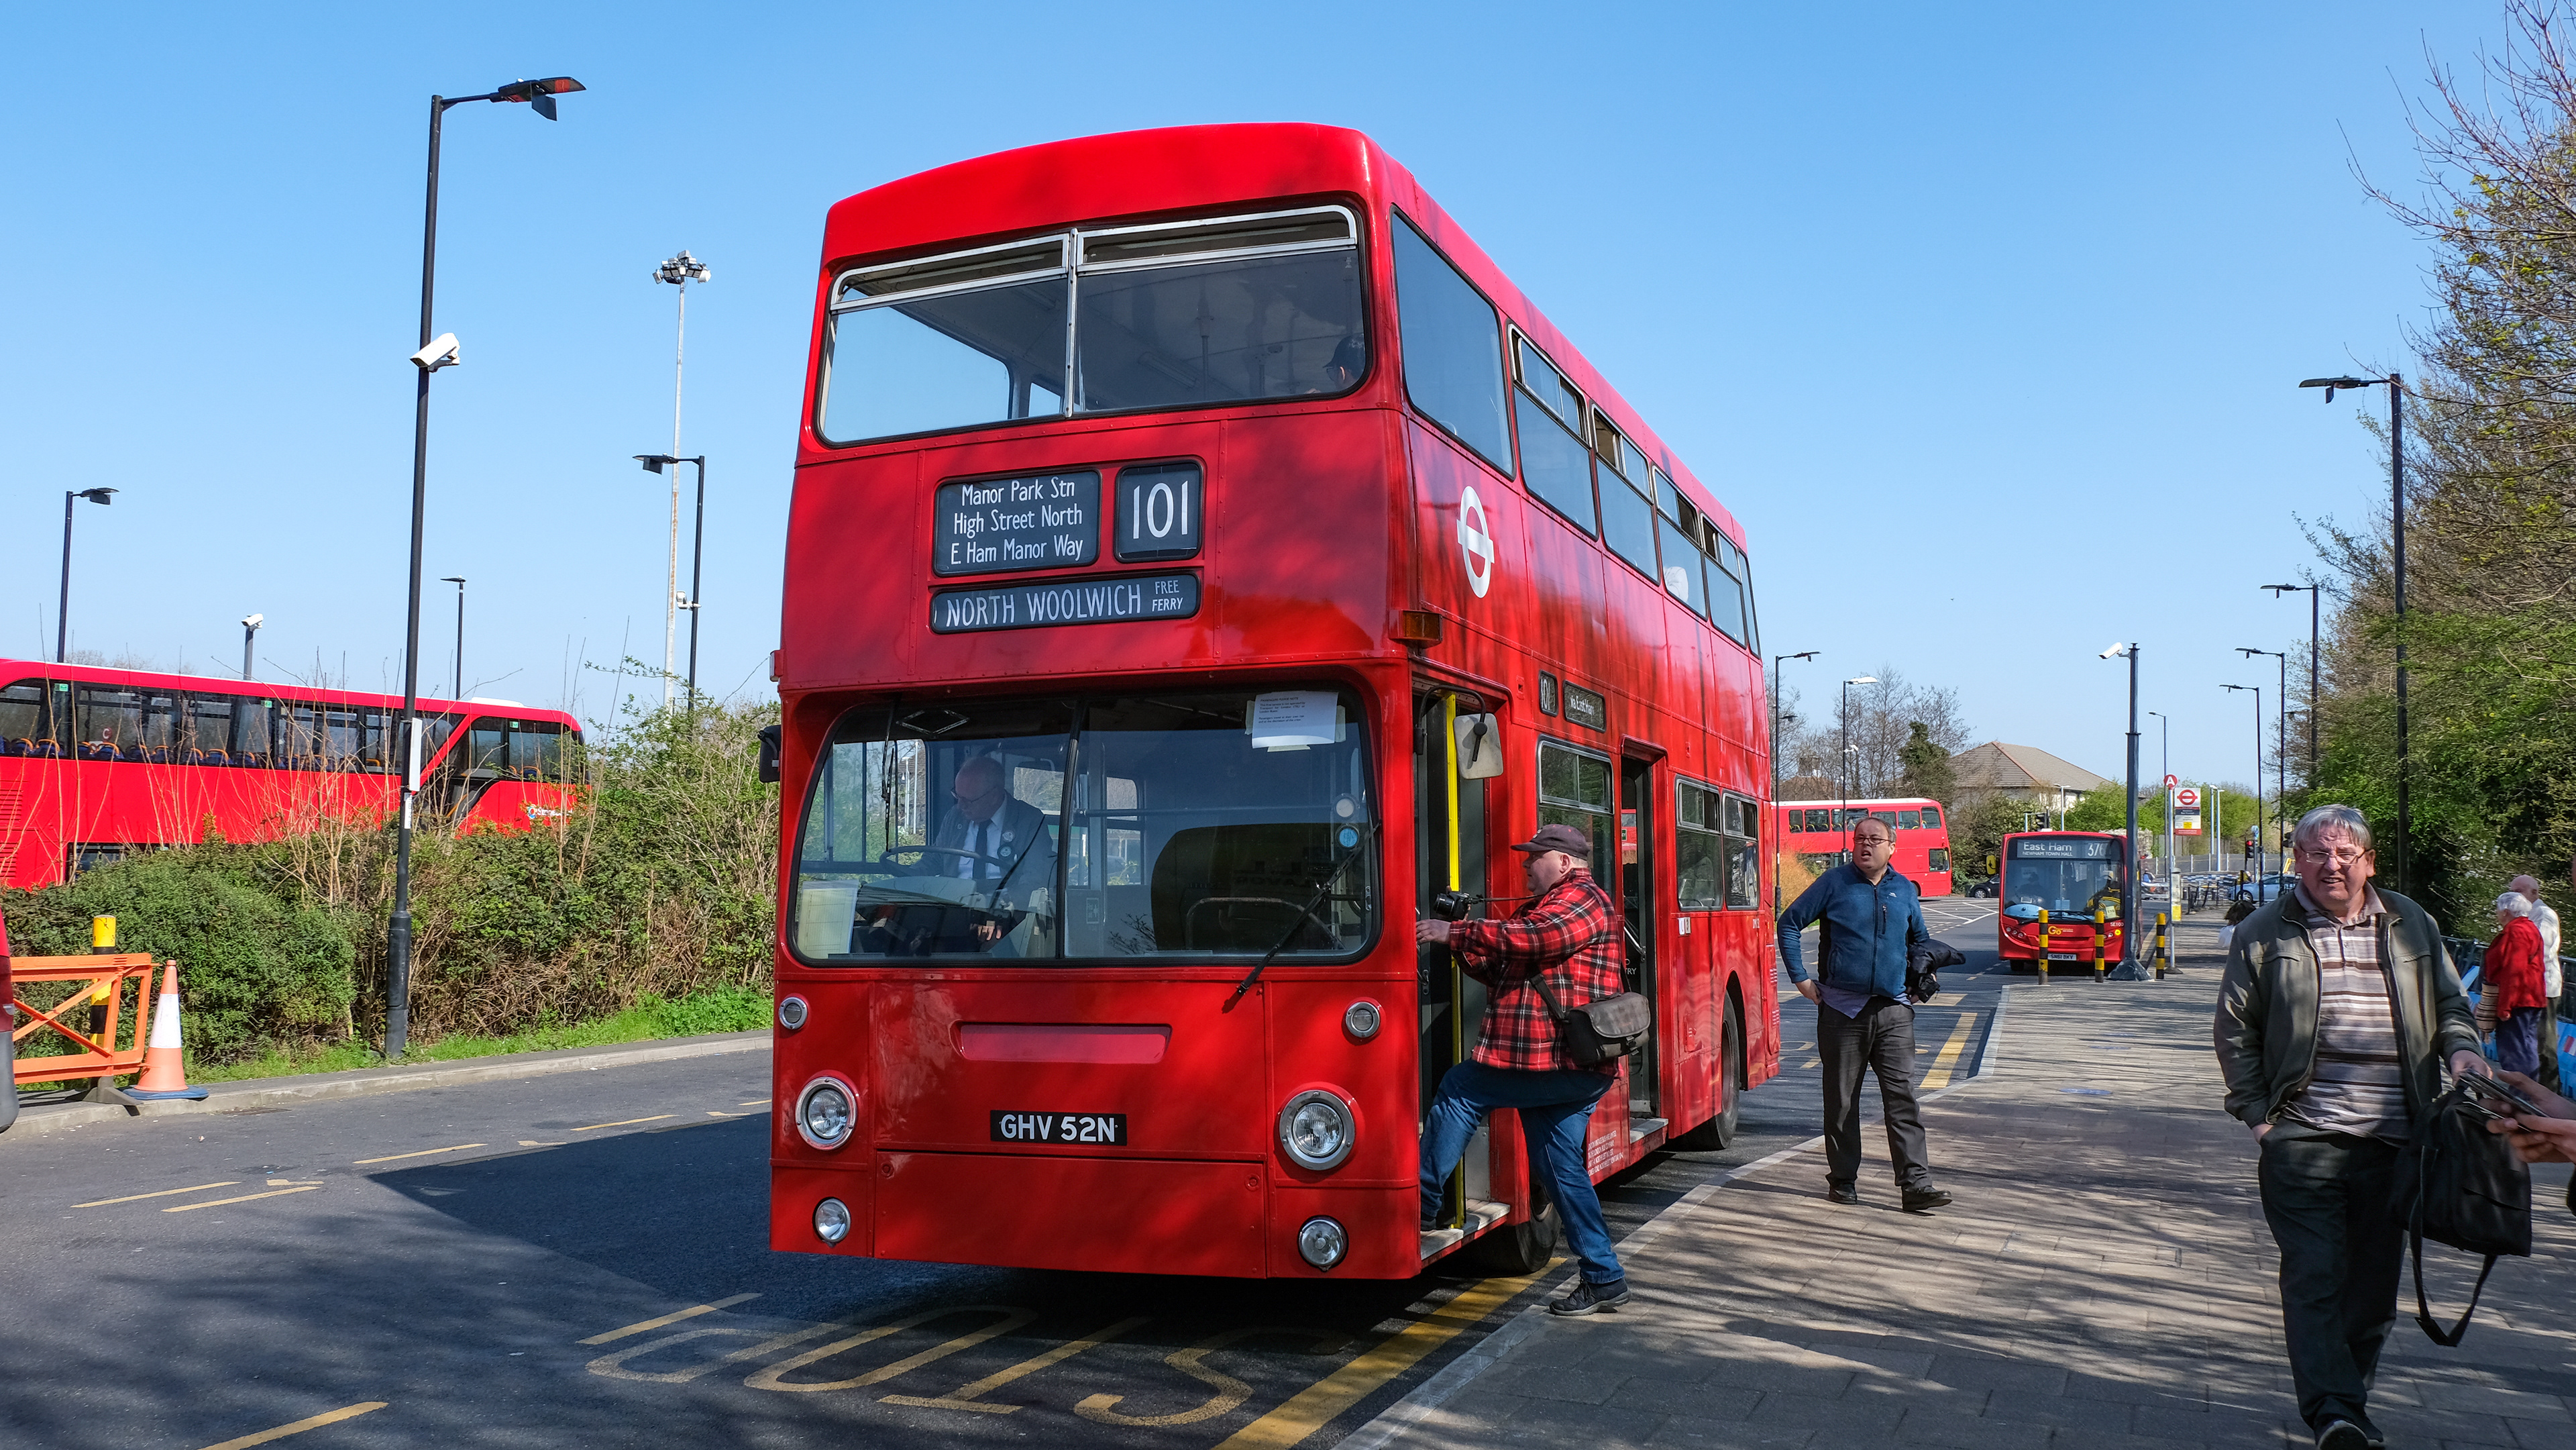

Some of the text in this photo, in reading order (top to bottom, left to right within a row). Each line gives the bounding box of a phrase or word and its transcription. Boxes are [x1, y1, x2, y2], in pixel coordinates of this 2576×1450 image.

[961, 476, 1075, 507] Manor Park Stn
[1133, 480, 1188, 539] 101
[954, 503, 1083, 539] High Street North
[966, 540, 998, 564] Ham
[1003, 537, 1047, 561] Manor
[1053, 534, 1083, 562] Way
[1155, 580, 1179, 595] FREE
[946, 584, 1141, 628] NORTH WOOLWICH
[1152, 597, 1183, 613] FERRY
[1540, 679, 1550, 711] 101
[1576, 696, 1586, 713] East
[1585, 699, 1594, 715] Ham
[102, 728, 110, 739] C
[2166, 776, 2176, 786] A
[2023, 841, 2072, 851] East Ham
[2088, 843, 2106, 856] 376
[2048, 926, 2061, 935] Go
[1000, 1114, 1115, 1142] GHV 52N
